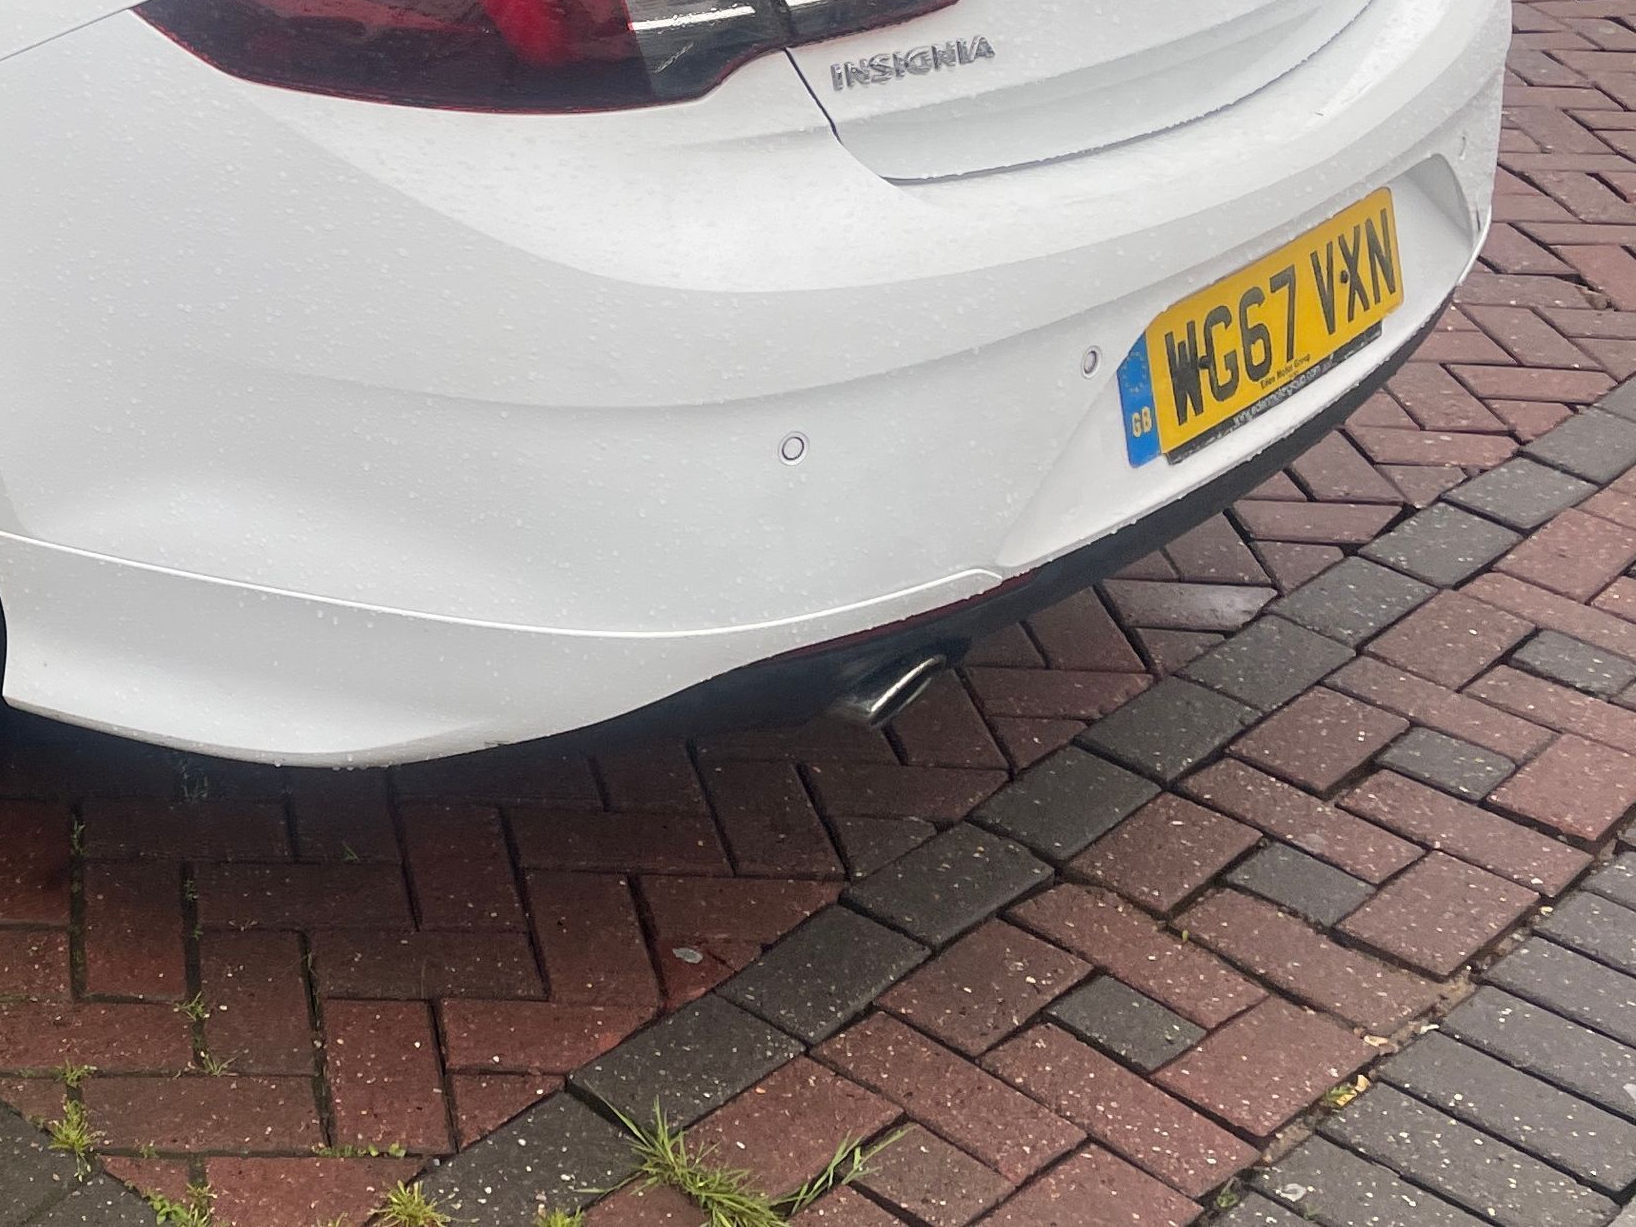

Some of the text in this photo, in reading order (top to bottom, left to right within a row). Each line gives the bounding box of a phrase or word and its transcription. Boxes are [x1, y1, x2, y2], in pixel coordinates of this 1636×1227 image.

[830, 35, 996, 92] INSIGNIA
[1164, 207, 1396, 426] WG67 VXN
[1131, 406, 1152, 438] GB
